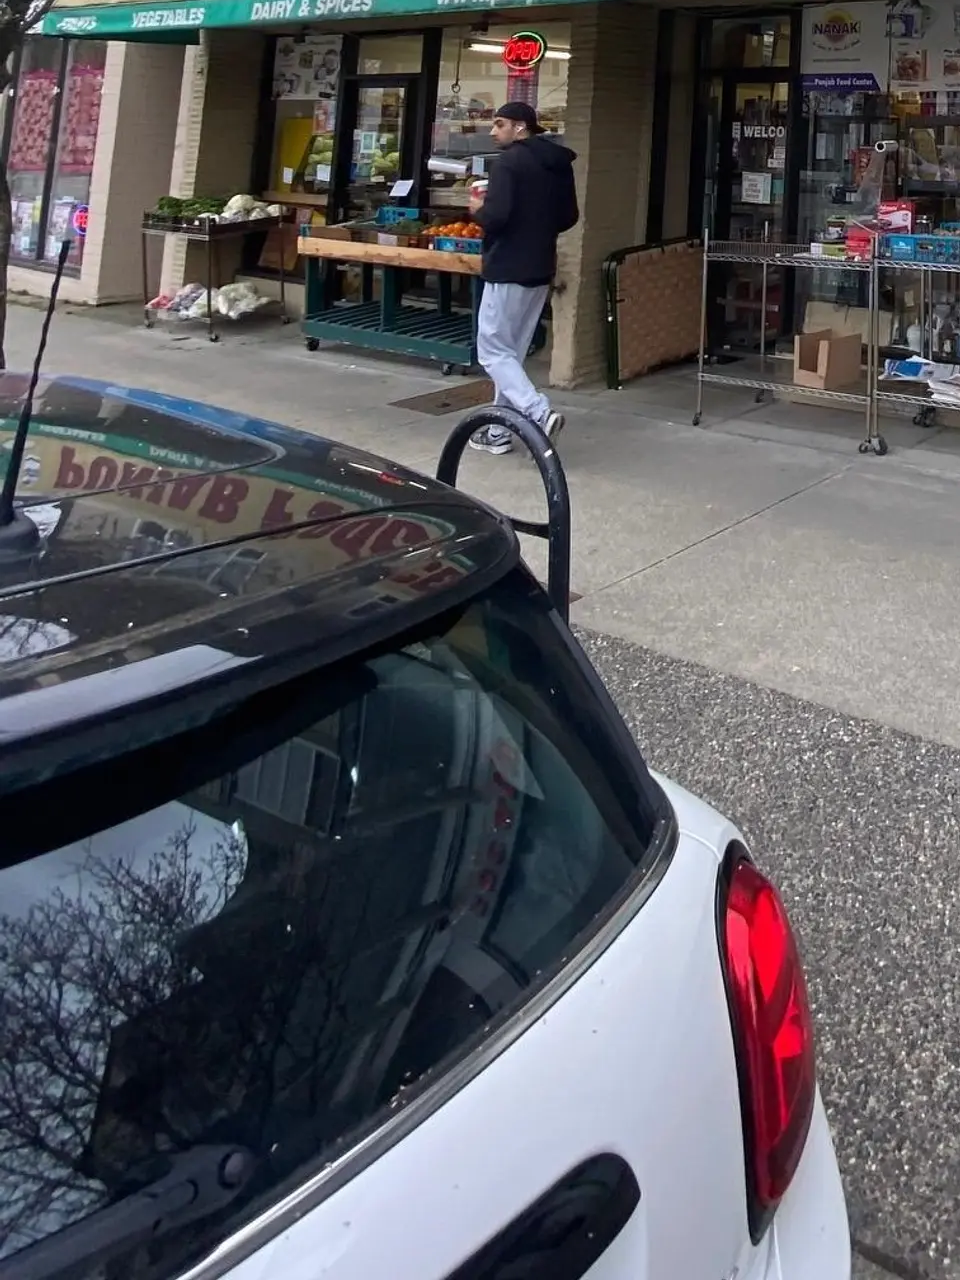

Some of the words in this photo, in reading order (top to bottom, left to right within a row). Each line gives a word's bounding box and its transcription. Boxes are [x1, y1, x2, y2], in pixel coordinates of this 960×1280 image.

[131, 7, 205, 29] VEGETABLES
[814, 21, 859, 35] NANAK
[506, 41, 541, 61] OPEN
